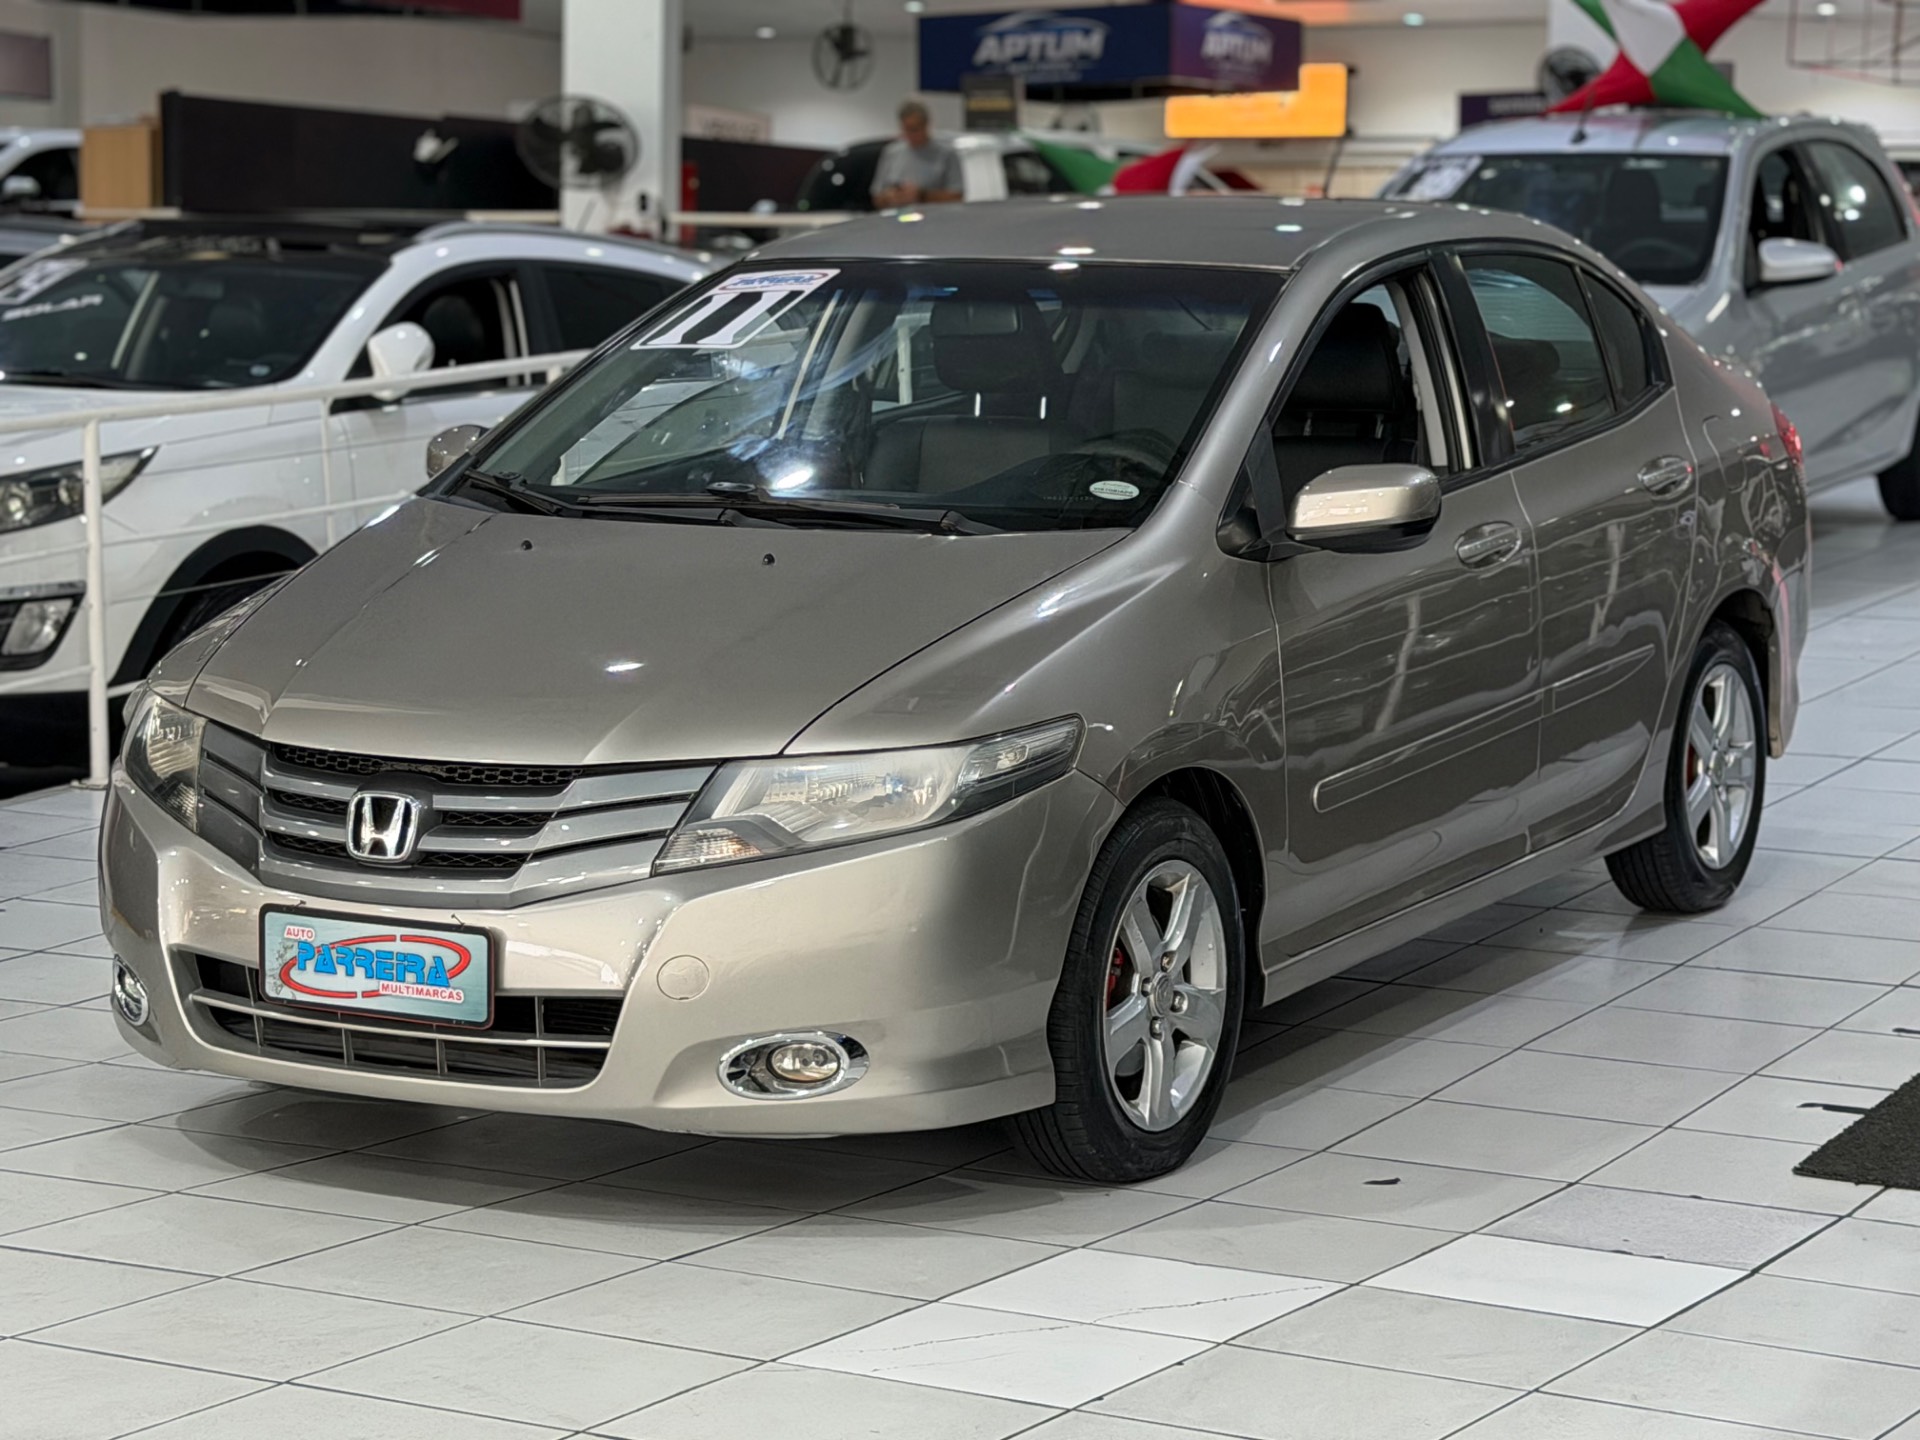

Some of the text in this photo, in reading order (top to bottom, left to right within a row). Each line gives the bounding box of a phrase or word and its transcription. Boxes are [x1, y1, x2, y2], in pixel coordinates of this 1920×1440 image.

[971, 27, 1107, 67] APTUM
[647, 290, 791, 345] 11
[285, 927, 315, 940] AUTO
[296, 940, 451, 988] PARREIRA
[380, 983, 464, 1001] MULTIMARCAS
